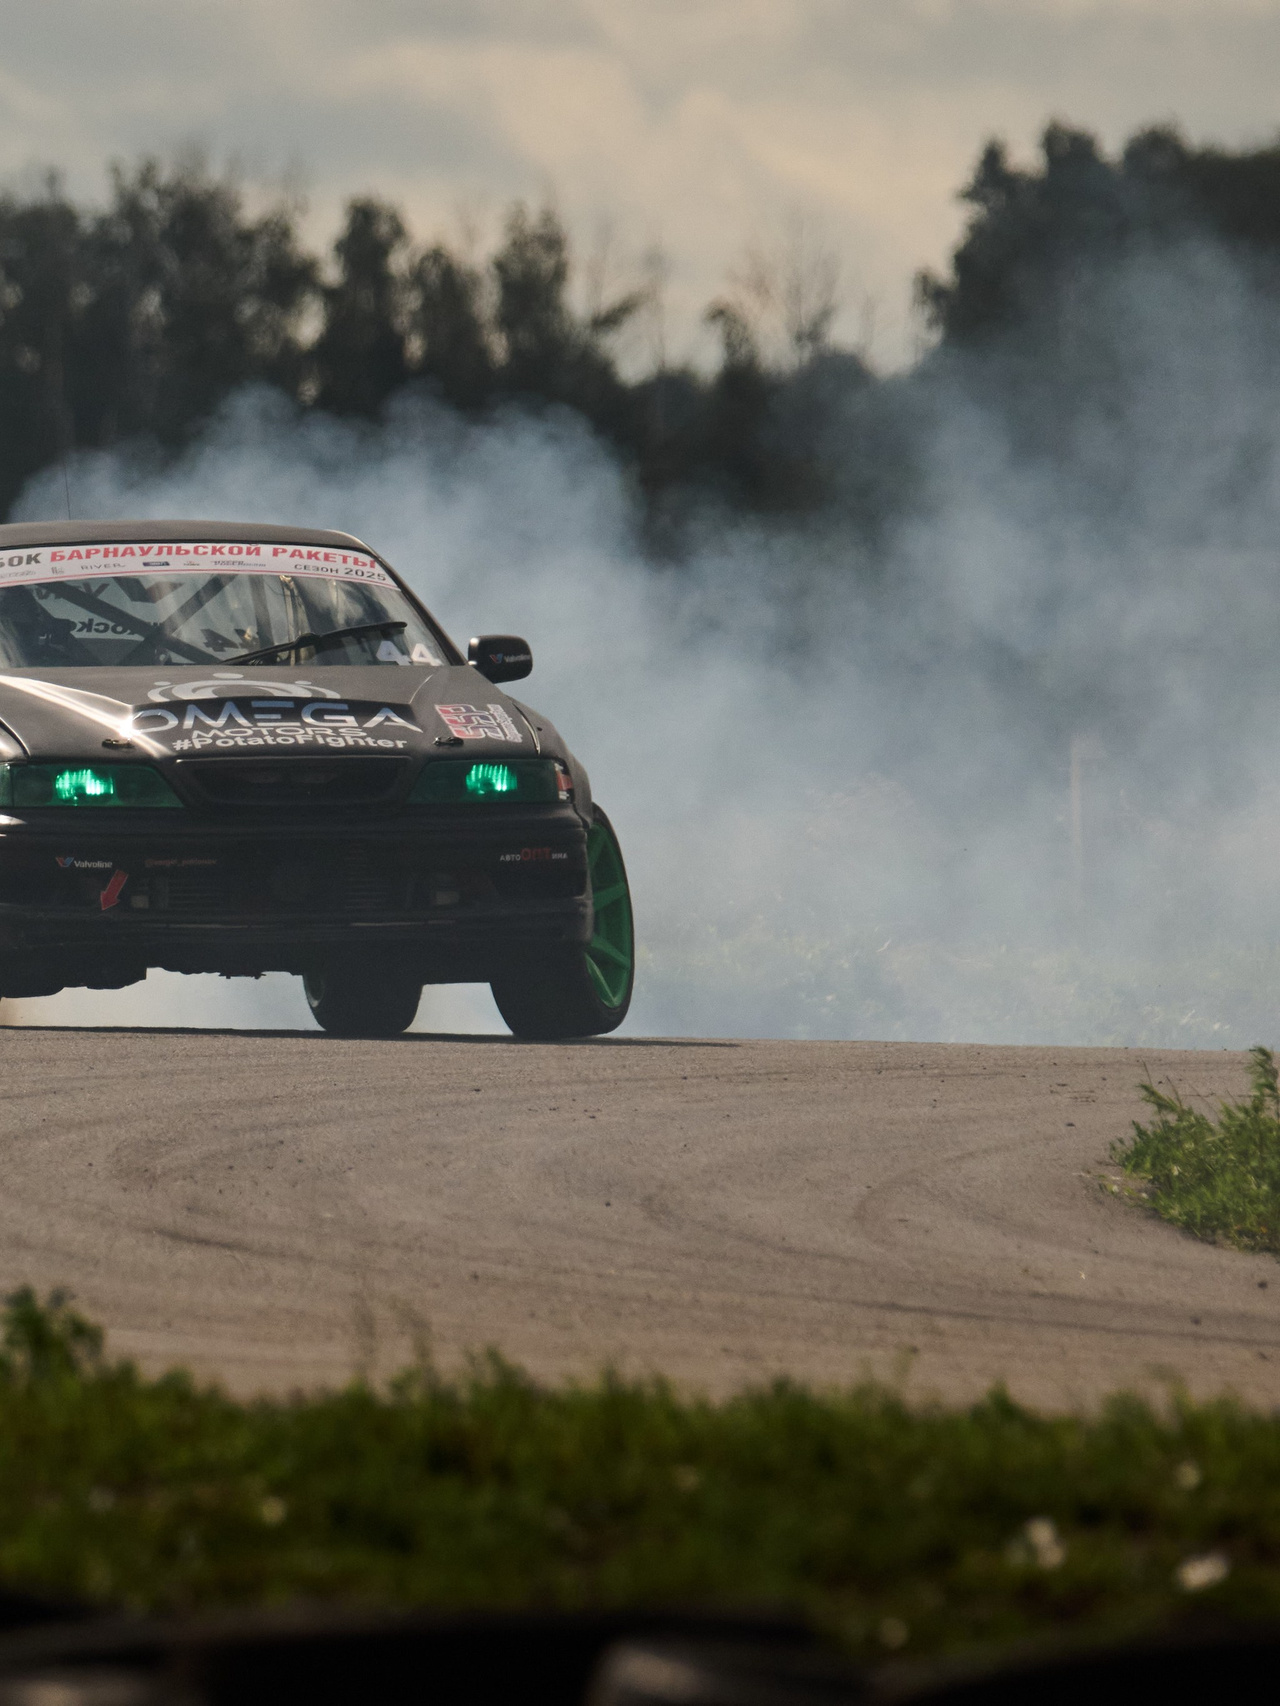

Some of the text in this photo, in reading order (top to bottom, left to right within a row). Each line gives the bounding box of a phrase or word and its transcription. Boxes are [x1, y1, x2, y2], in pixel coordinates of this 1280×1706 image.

[49, 543, 261, 563] БАРНАУЛЬСКОЙ
[272, 546, 377, 569] РАКЕТЫ
[294, 564, 387, 581] СЕЗОН 2025
[375, 640, 445, 666] 44
[130, 700, 423, 733] OMEGA
[192, 727, 368, 738] MOTORS
[172, 734, 408, 751] #PotatoFighter
[74, 860, 113, 869] Valvoline
